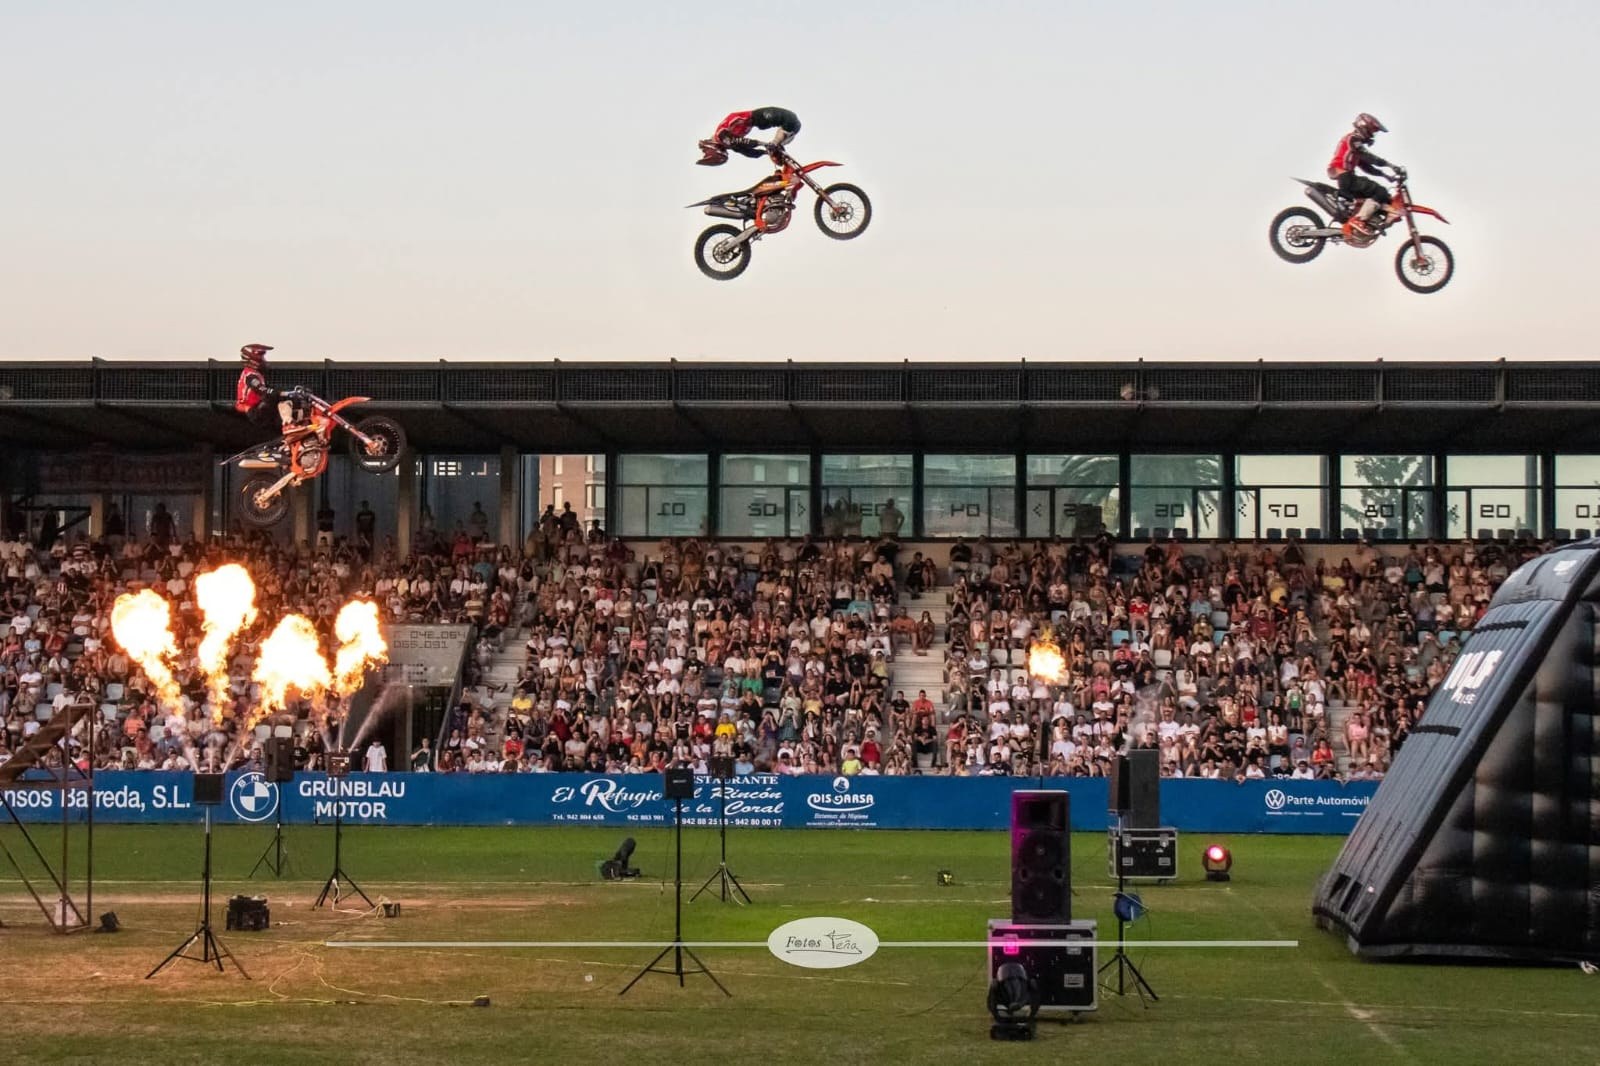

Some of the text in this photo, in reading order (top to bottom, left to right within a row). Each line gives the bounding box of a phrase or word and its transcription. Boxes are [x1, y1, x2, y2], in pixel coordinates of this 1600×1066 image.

[299, 777, 405, 798] GRÜNBLAU
[694, 775, 779, 785] STAURANTE
[0, 790, 53, 808] nsos
[152, 785, 191, 808] S.L.
[551, 778, 663, 813] El Refugio
[710, 787, 783, 800] Rincón
[1286, 795, 1314, 805] Parte
[316, 801, 386, 819] MOTOR
[696, 804, 713, 813] la
[724, 800, 785, 815] Coral
